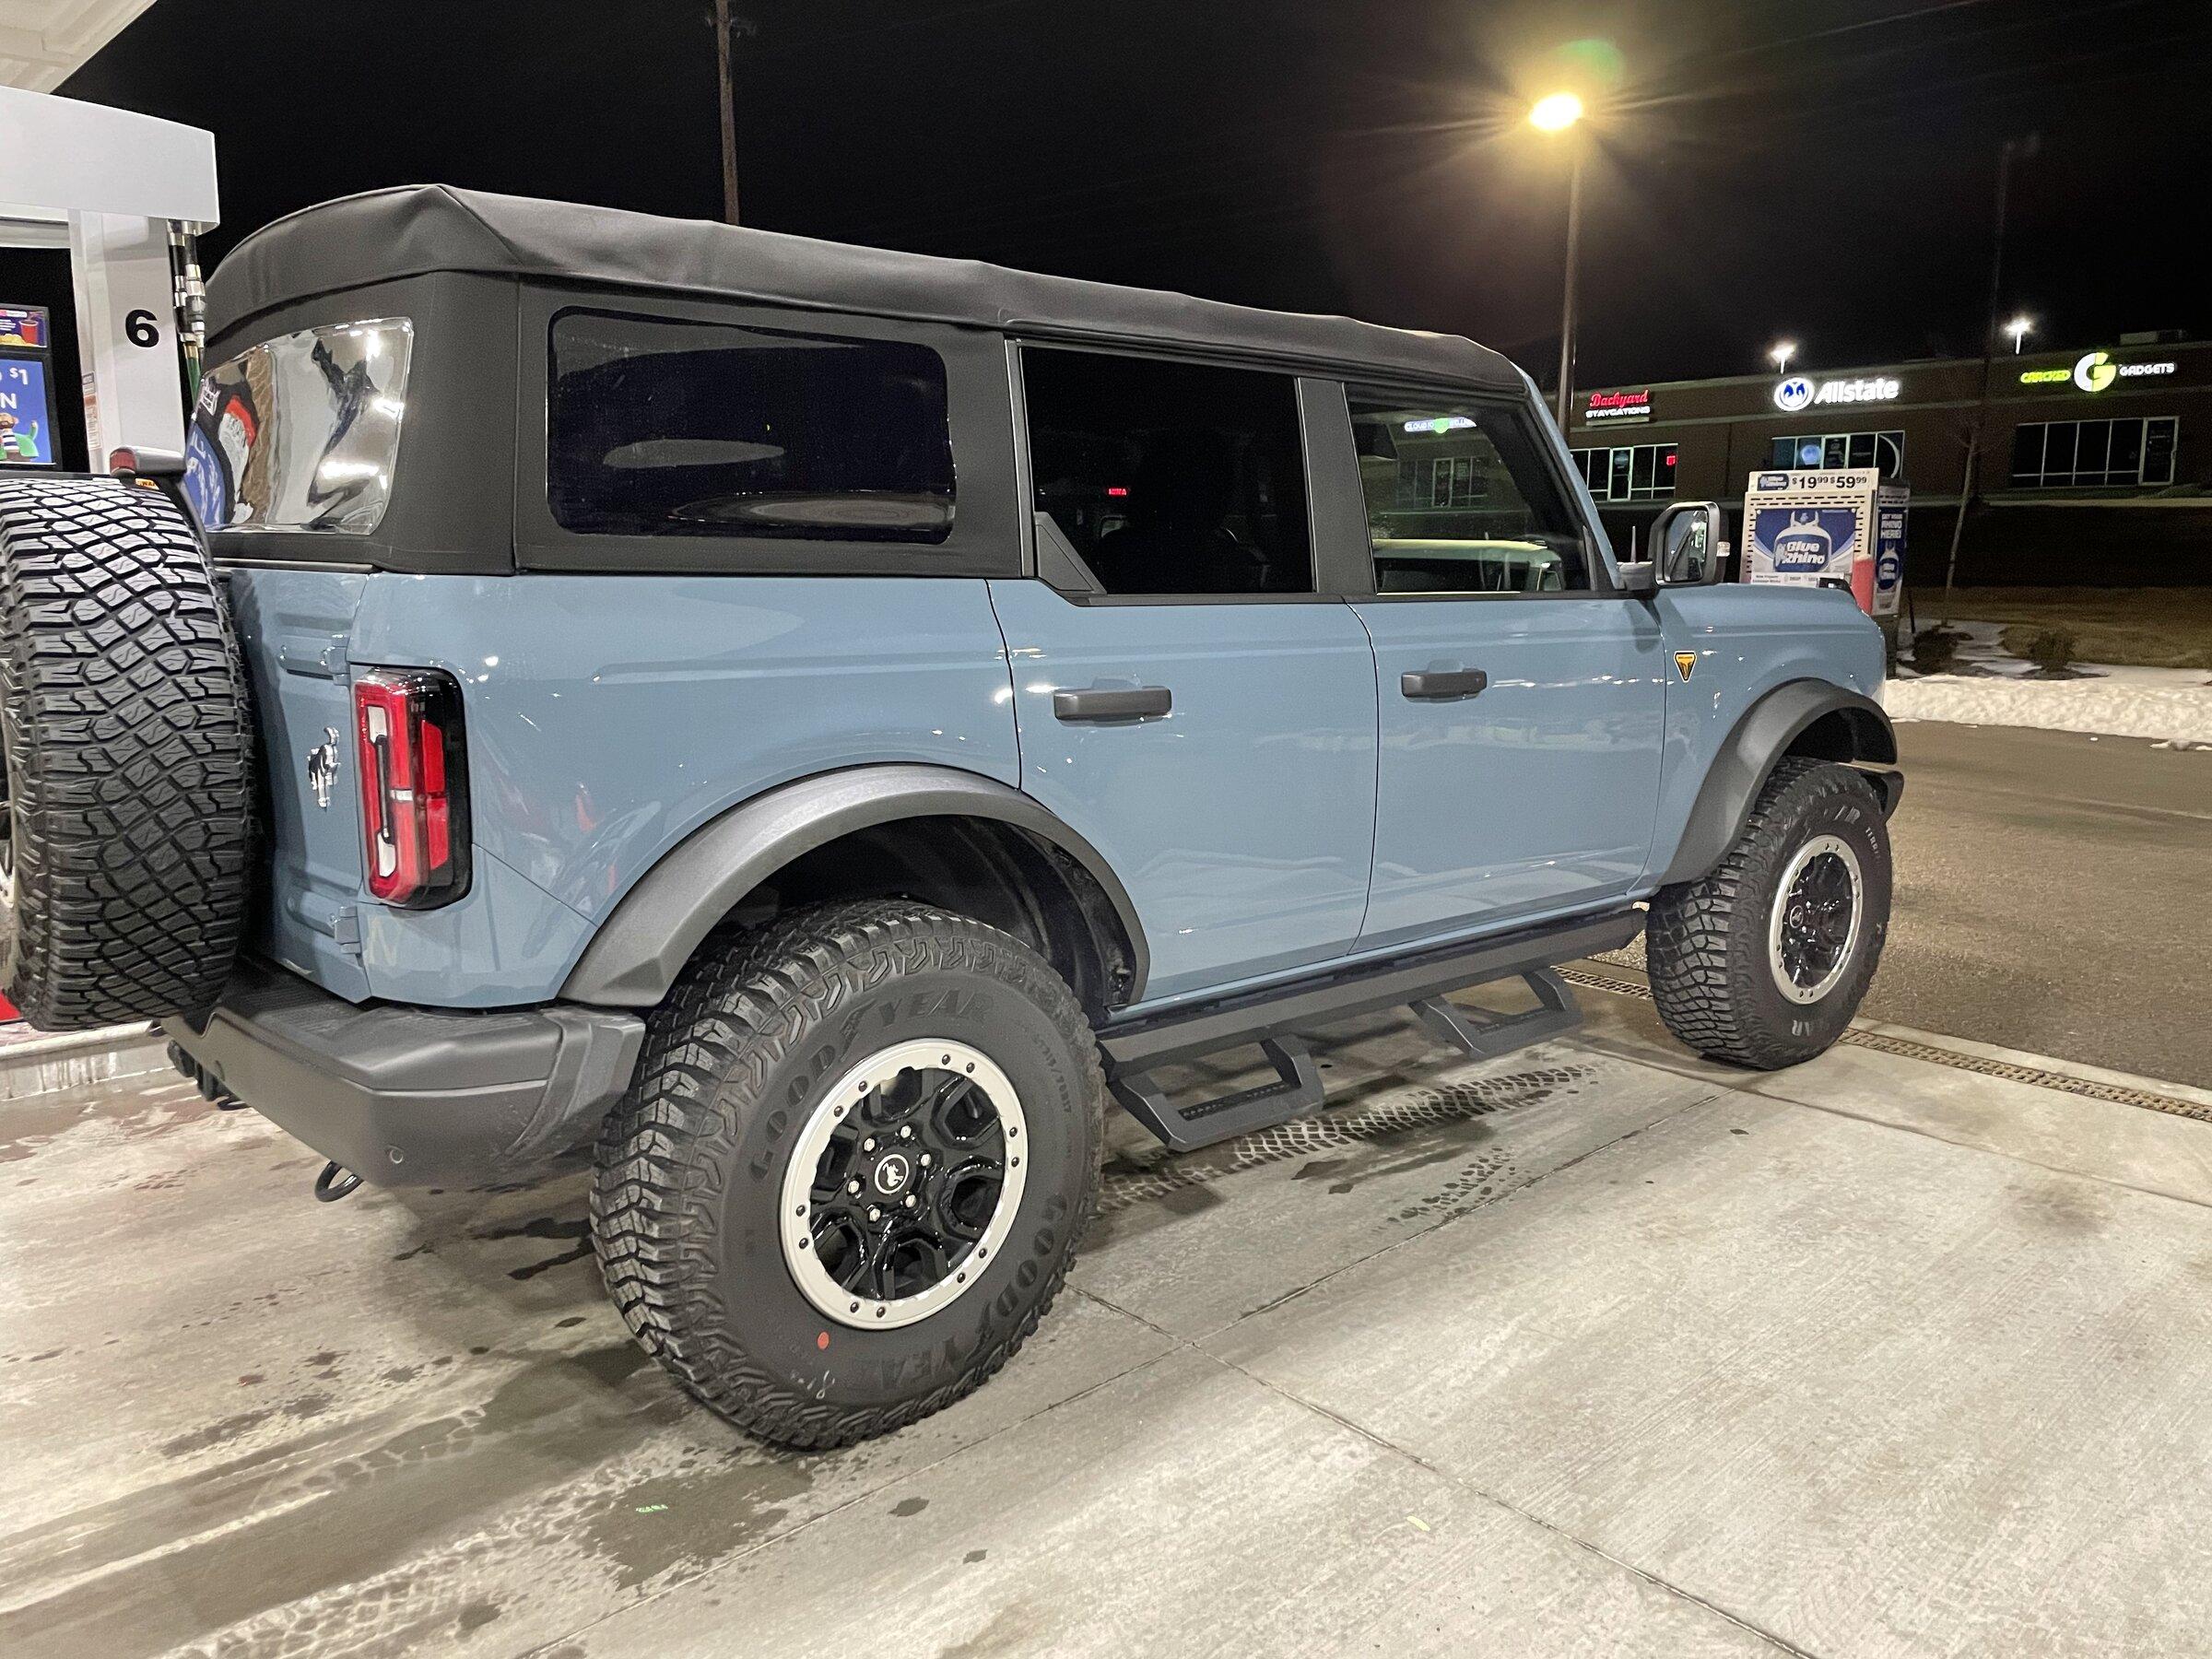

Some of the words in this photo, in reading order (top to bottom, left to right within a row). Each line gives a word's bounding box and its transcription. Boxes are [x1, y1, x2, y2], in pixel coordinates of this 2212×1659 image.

[124, 309, 160, 348] 6
[9, 367, 29, 385] $1
[2120, 362, 2175, 377] GADGETS
[1589, 389, 1649, 407] Backyard
[1814, 378, 1900, 404] Allstate
[1787, 541, 1820, 553] Blue
